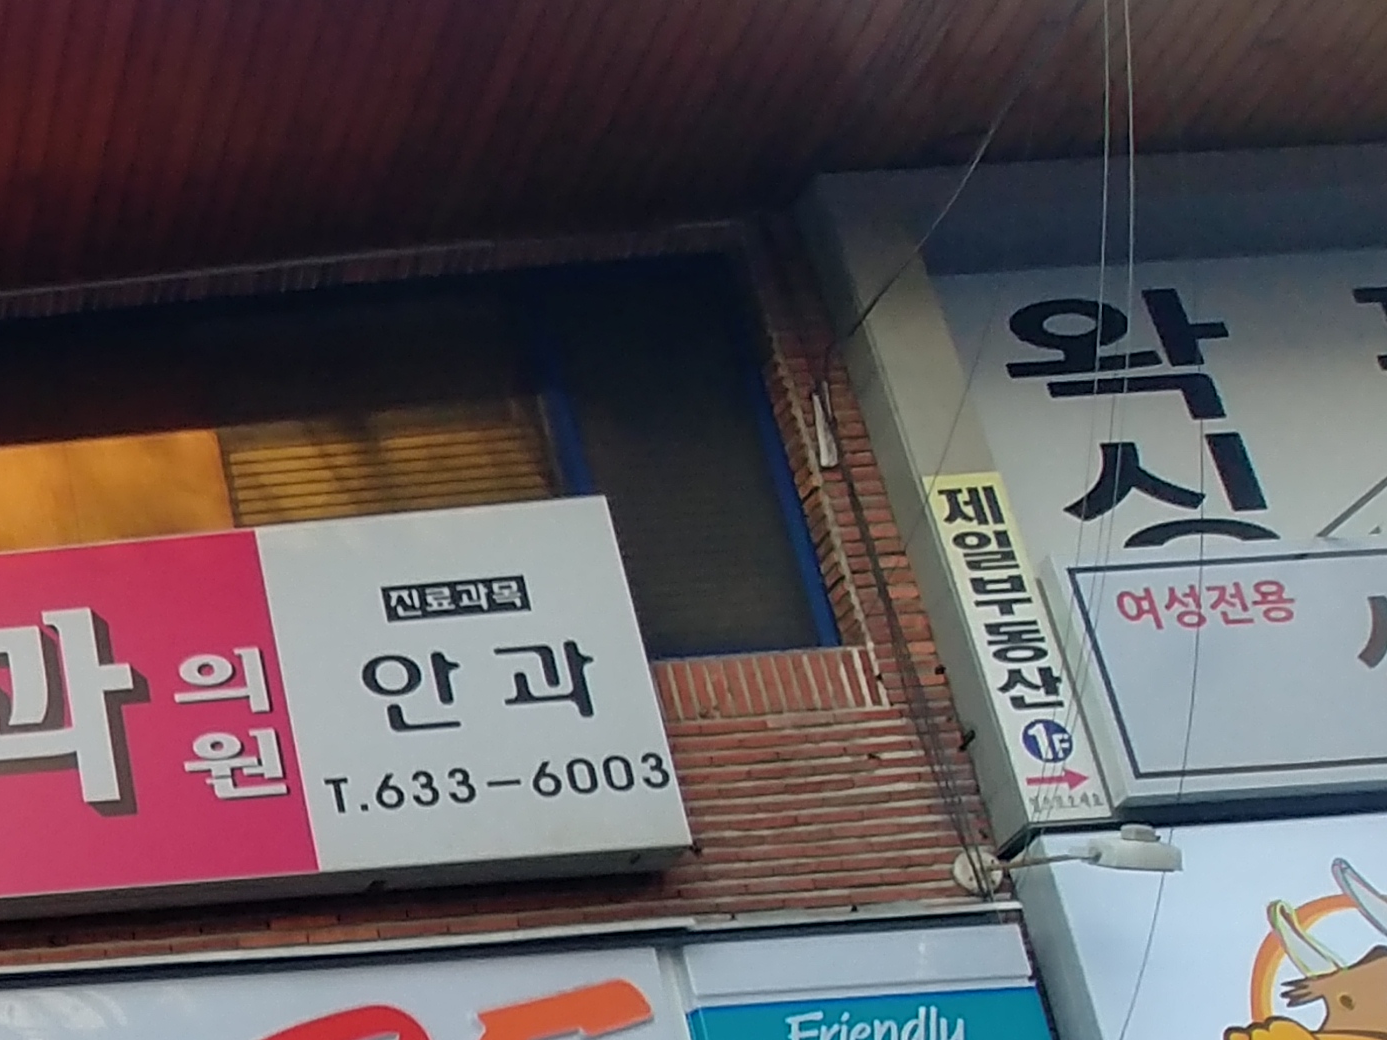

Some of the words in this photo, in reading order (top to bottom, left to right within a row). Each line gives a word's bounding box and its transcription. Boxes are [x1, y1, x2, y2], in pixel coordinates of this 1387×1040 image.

[389, 578, 524, 619] 진료과목
[938, 484, 1065, 711] 제일부동산
[1116, 580, 1296, 630] 여성전용
[361, 640, 595, 733] 안과
[173, 645, 290, 800] 의원
[1026, 722, 1070, 760] 1F
[323, 752, 670, 813] T.633-6003
